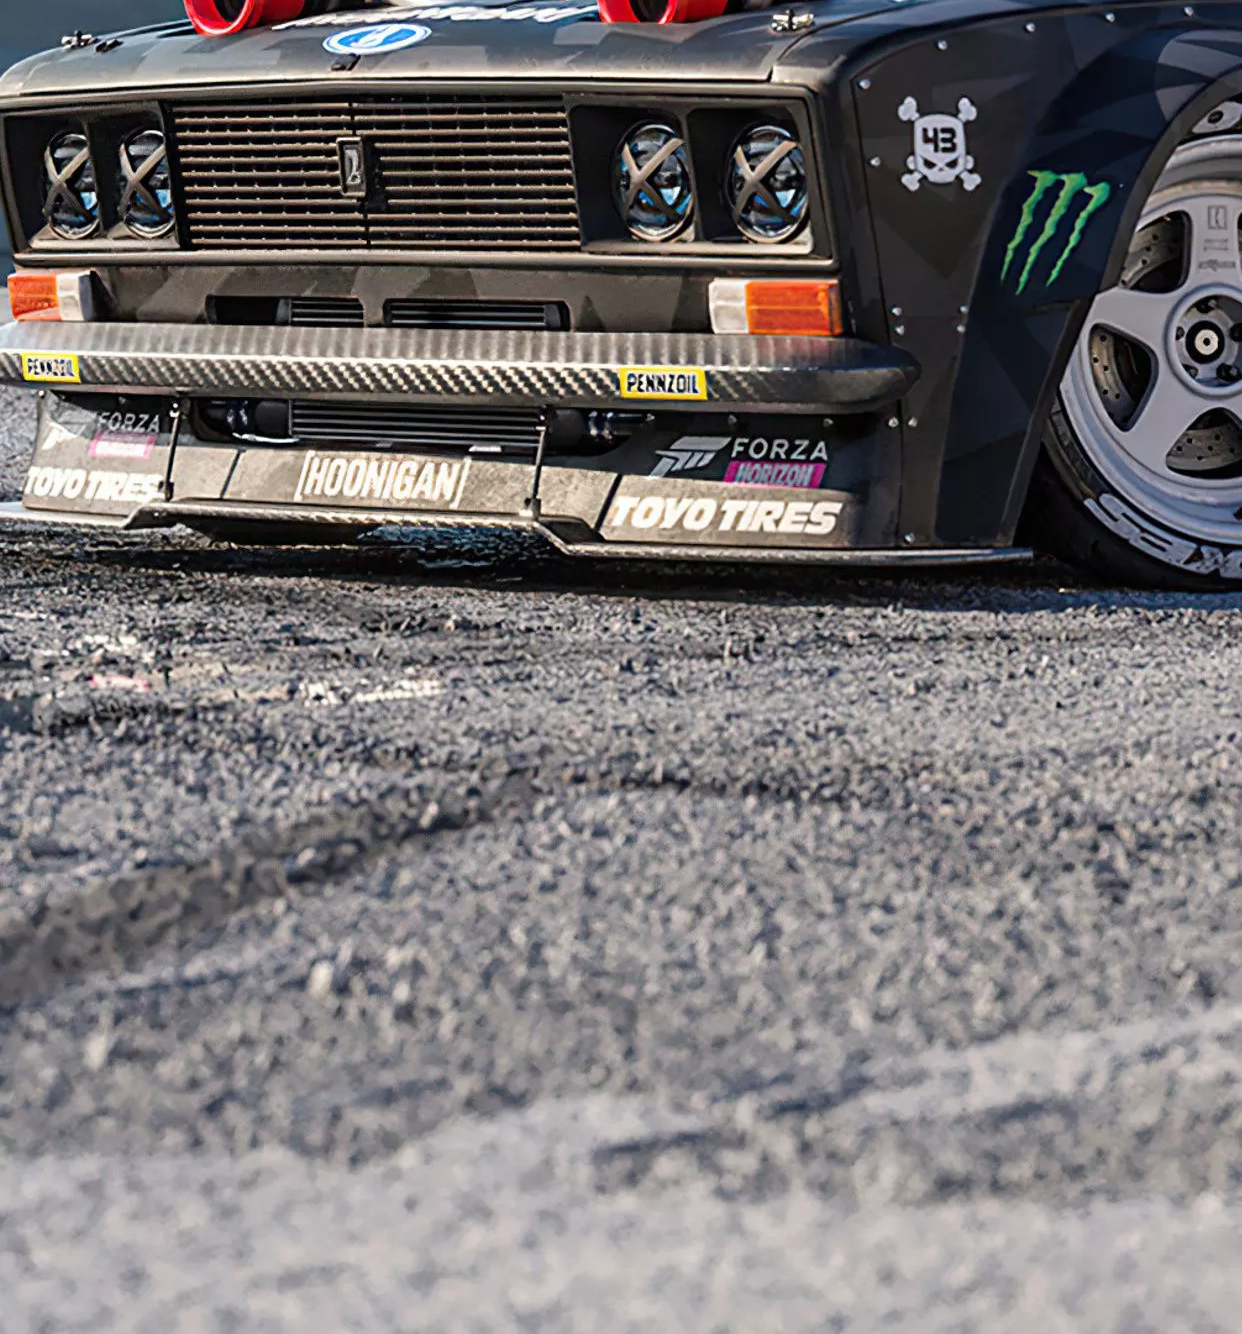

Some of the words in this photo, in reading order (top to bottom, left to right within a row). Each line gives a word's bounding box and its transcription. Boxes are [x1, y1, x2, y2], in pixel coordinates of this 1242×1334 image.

[921, 126, 958, 154] 43
[626, 371, 700, 395] PENNZOIL
[97, 411, 161, 434] FORZA
[730, 437, 829, 462] FORZA
[23, 465, 88, 499] TOYO
[84, 469, 167, 503] TIRES
[733, 463, 816, 488] HORIZON
[610, 494, 719, 530] TOYO
[717, 498, 844, 536] TIRES
